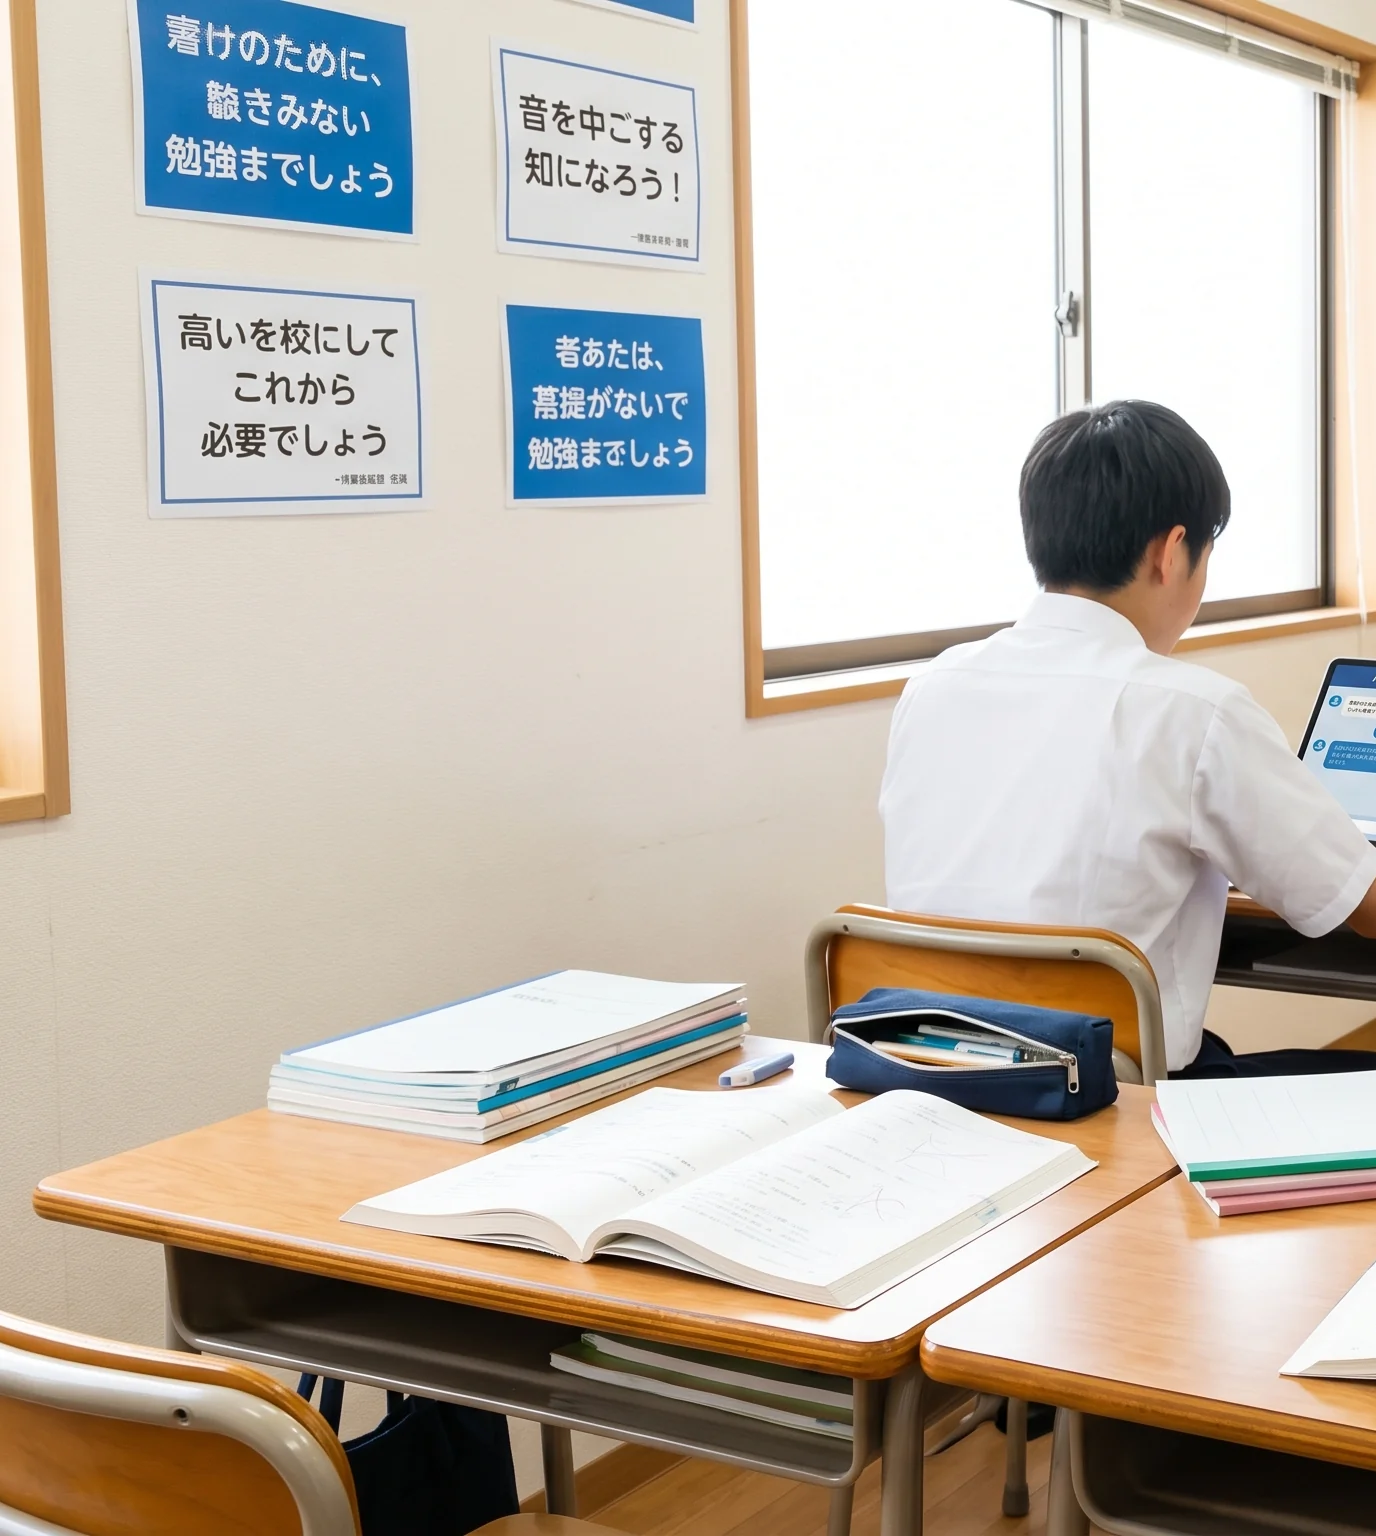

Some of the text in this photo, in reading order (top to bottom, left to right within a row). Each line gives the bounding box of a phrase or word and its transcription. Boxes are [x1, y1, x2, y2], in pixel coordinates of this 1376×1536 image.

[519, 94, 683, 153] 音を中ごする
[165, 134, 393, 198] 勉強までしょう
[178, 313, 398, 357] 高いを校にして
[234, 371, 355, 405] これから
[201, 422, 386, 458] 必要でしょう
